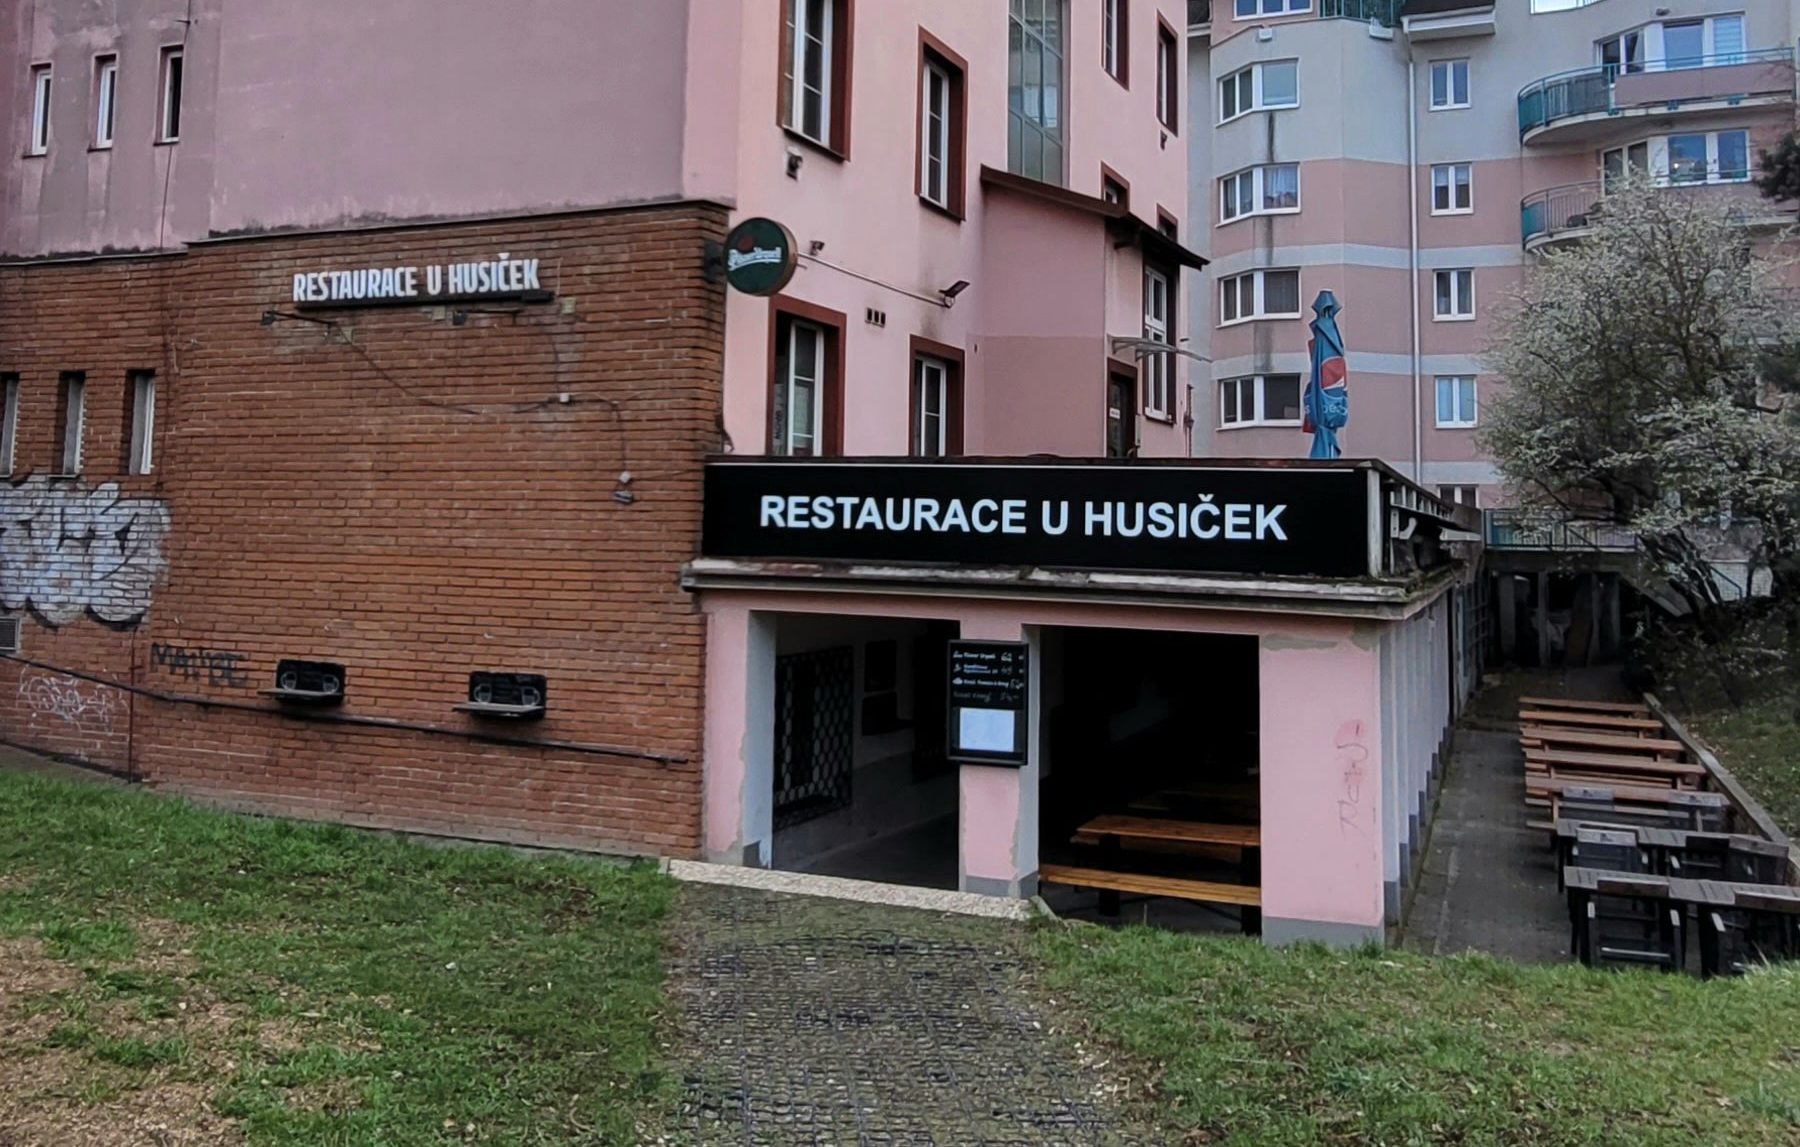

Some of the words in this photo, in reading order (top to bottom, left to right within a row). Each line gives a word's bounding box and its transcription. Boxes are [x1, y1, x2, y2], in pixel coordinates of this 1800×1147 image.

[293, 267, 418, 302] RESTAURACE
[426, 265, 442, 295] U
[448, 252, 541, 294] HUSIČEK
[760, 495, 1027, 534] RESTAURACE
[1042, 500, 1069, 536] U
[1084, 493, 1288, 541] HUSIČEK
